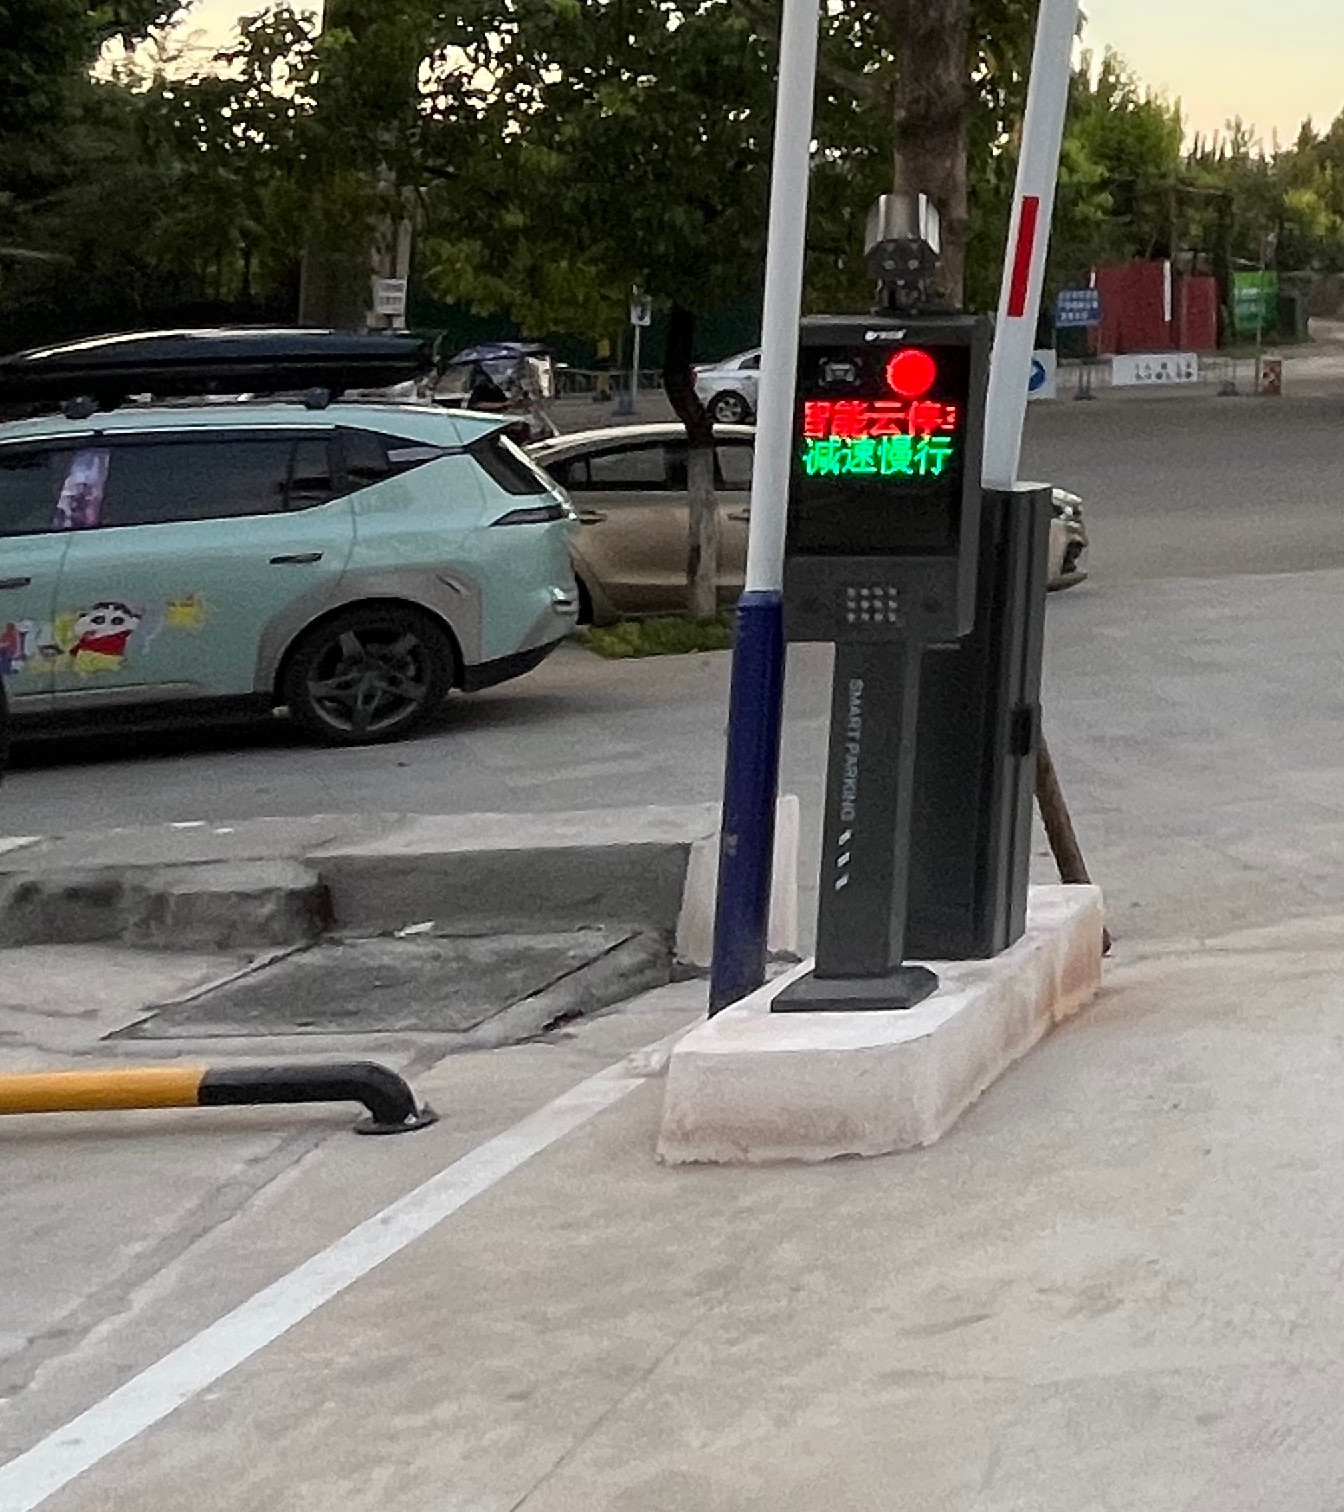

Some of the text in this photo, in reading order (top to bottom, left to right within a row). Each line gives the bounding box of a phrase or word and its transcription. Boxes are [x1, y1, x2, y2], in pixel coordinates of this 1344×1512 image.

[803, 435, 953, 476] 减速慢行
[840, 678, 864, 821] SMART PARKING
